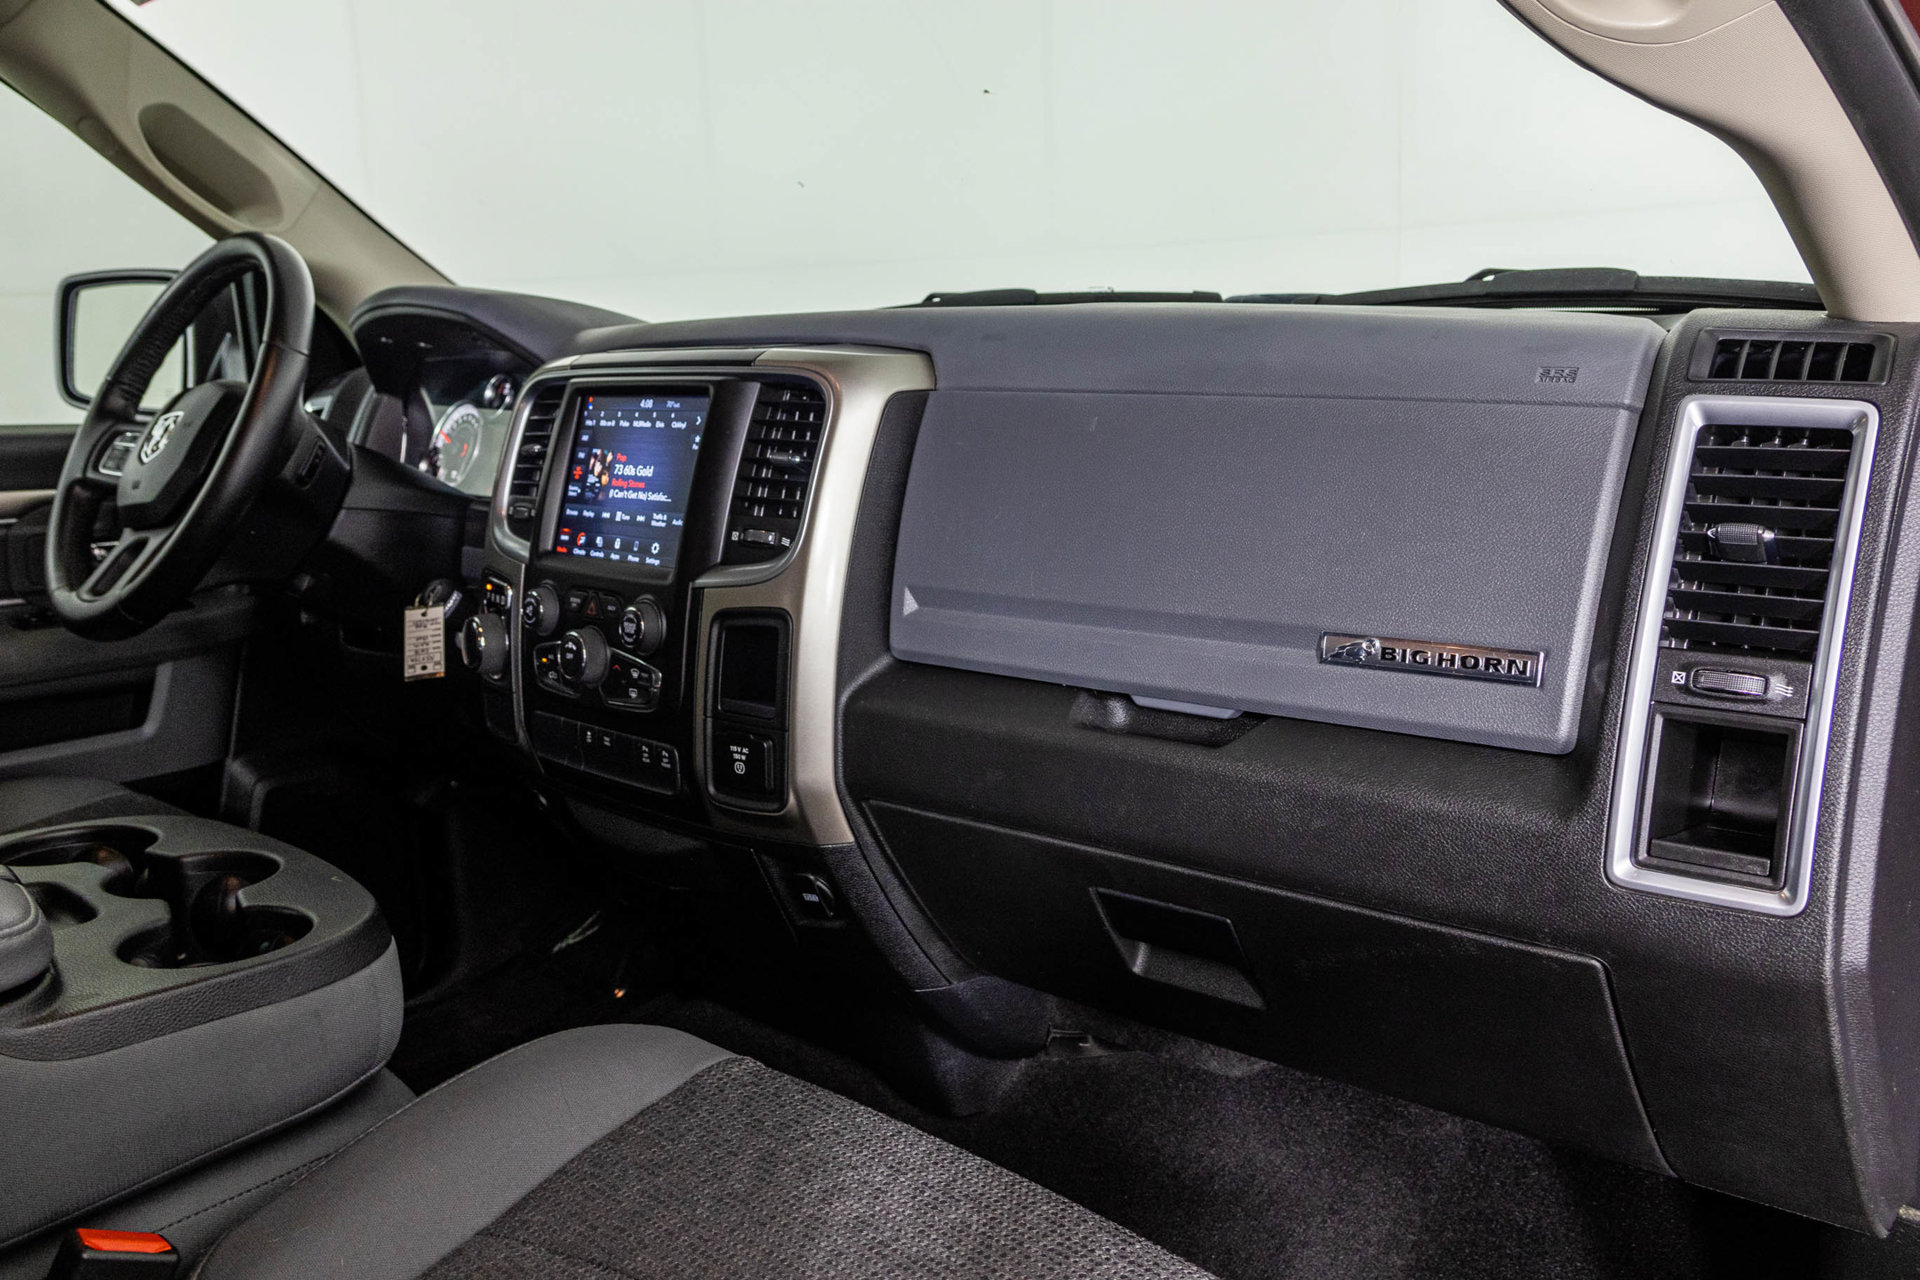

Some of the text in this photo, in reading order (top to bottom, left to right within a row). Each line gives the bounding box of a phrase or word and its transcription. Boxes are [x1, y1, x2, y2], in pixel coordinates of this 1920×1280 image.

[640, 399, 654, 408] 4:08
[616, 453, 627, 463] Pop
[613, 464, 654, 477] 73 60s Gold
[611, 478, 628, 489] Rolling
[628, 479, 645, 489] Stones
[614, 489, 628, 499] Can't
[628, 490, 637, 500] Get
